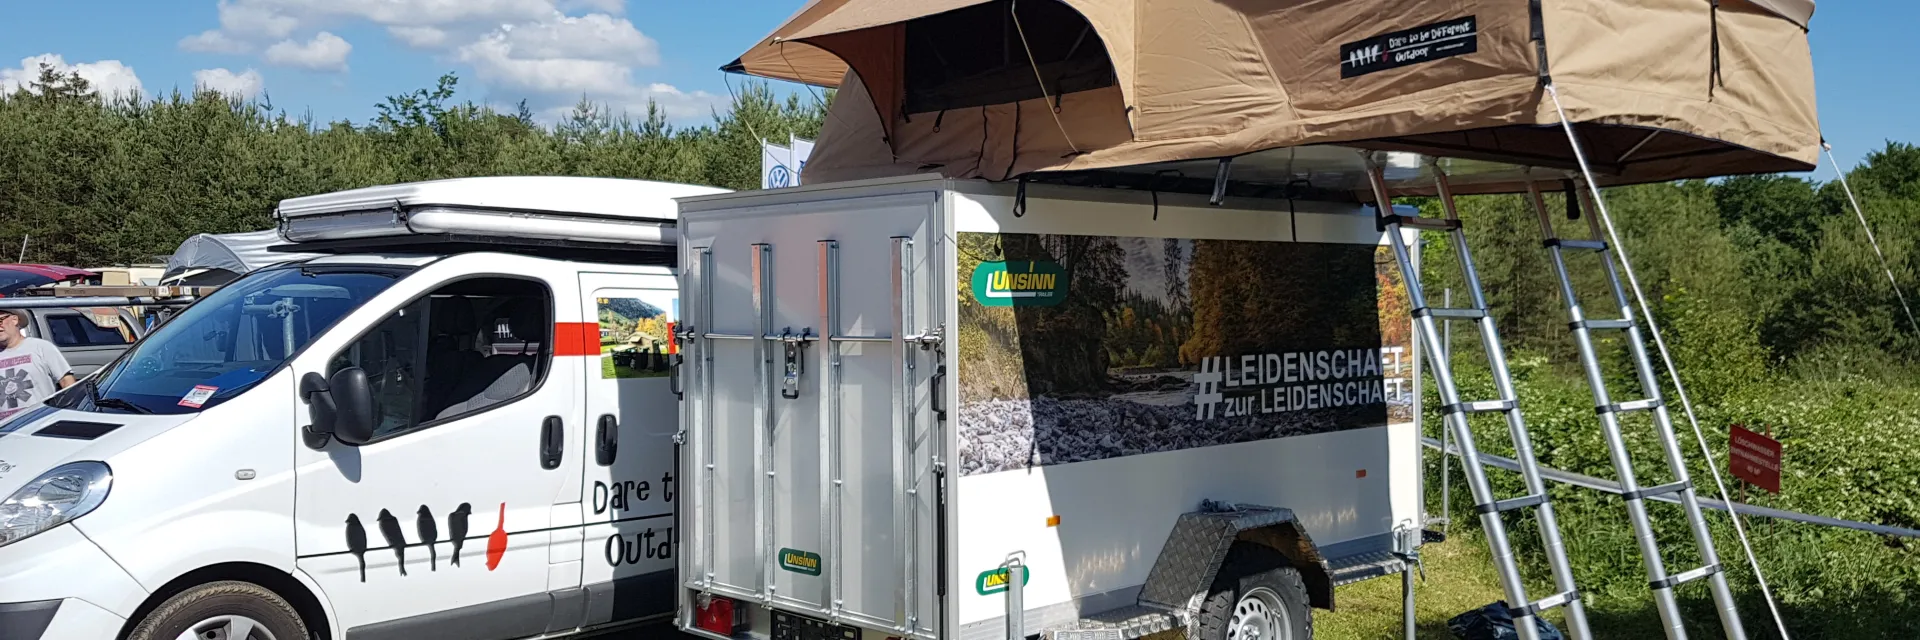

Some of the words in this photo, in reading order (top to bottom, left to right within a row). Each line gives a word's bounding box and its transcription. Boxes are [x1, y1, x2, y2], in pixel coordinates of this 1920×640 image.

[1389, 35, 1407, 49] Dare
[1409, 33, 1418, 43] to
[1420, 31, 1430, 42] be
[1395, 46, 1429, 63] Outdoor
[1224, 395, 1255, 417] zur
[1261, 378, 1404, 414] LEIDENSCHAFT
[593, 480, 650, 515] Dare
